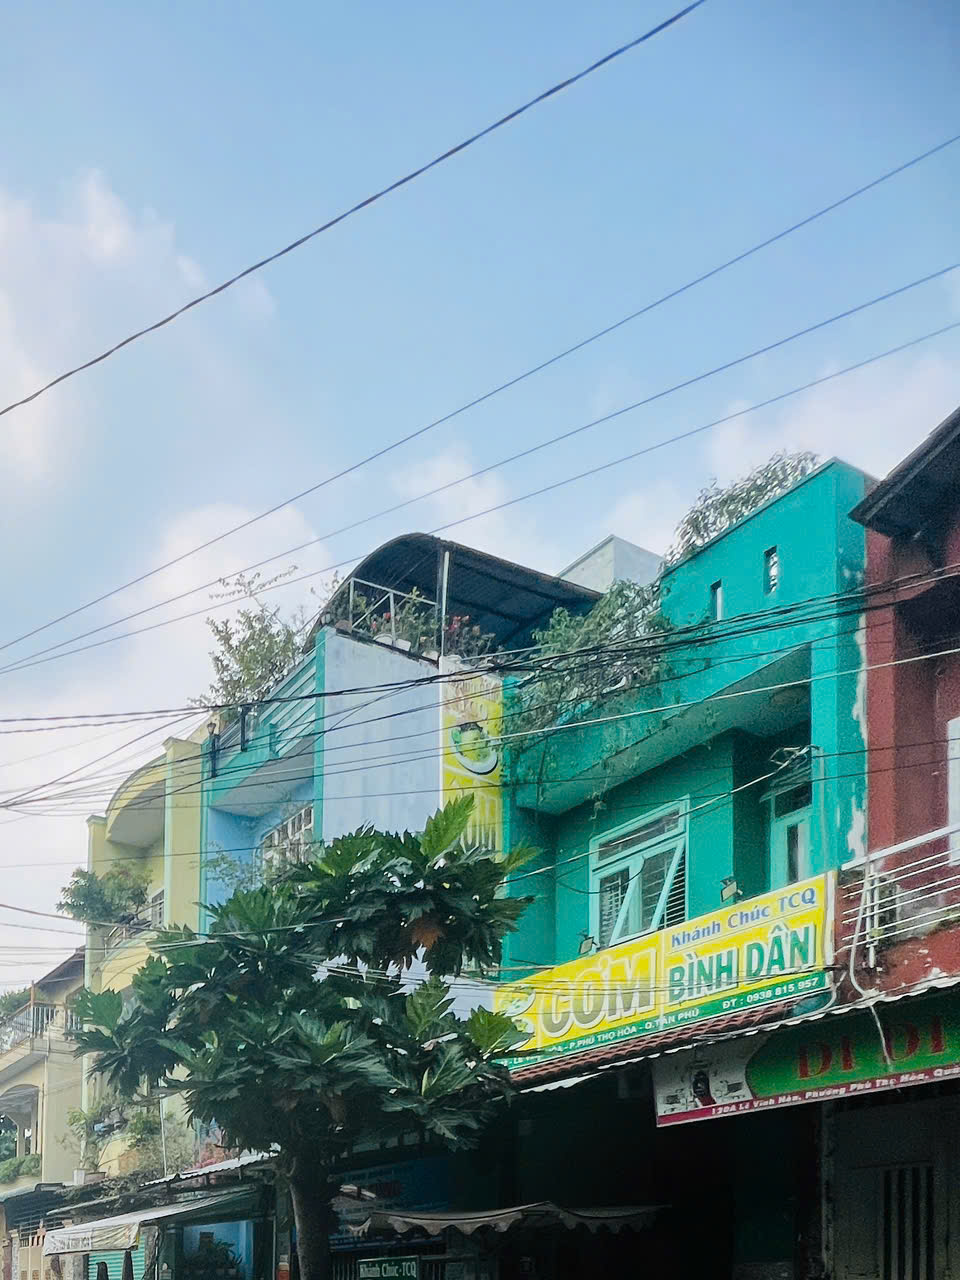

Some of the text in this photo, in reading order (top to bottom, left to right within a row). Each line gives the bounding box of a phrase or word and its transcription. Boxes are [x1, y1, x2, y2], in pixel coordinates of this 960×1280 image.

[671, 887, 816, 948] Khánh Chúc TCQ
[668, 922, 817, 1006] BÌNH DÂN
[746, 990, 772, 1004] 0938
[775, 984, 795, 997] 815
[797, 977, 819, 990] 957
